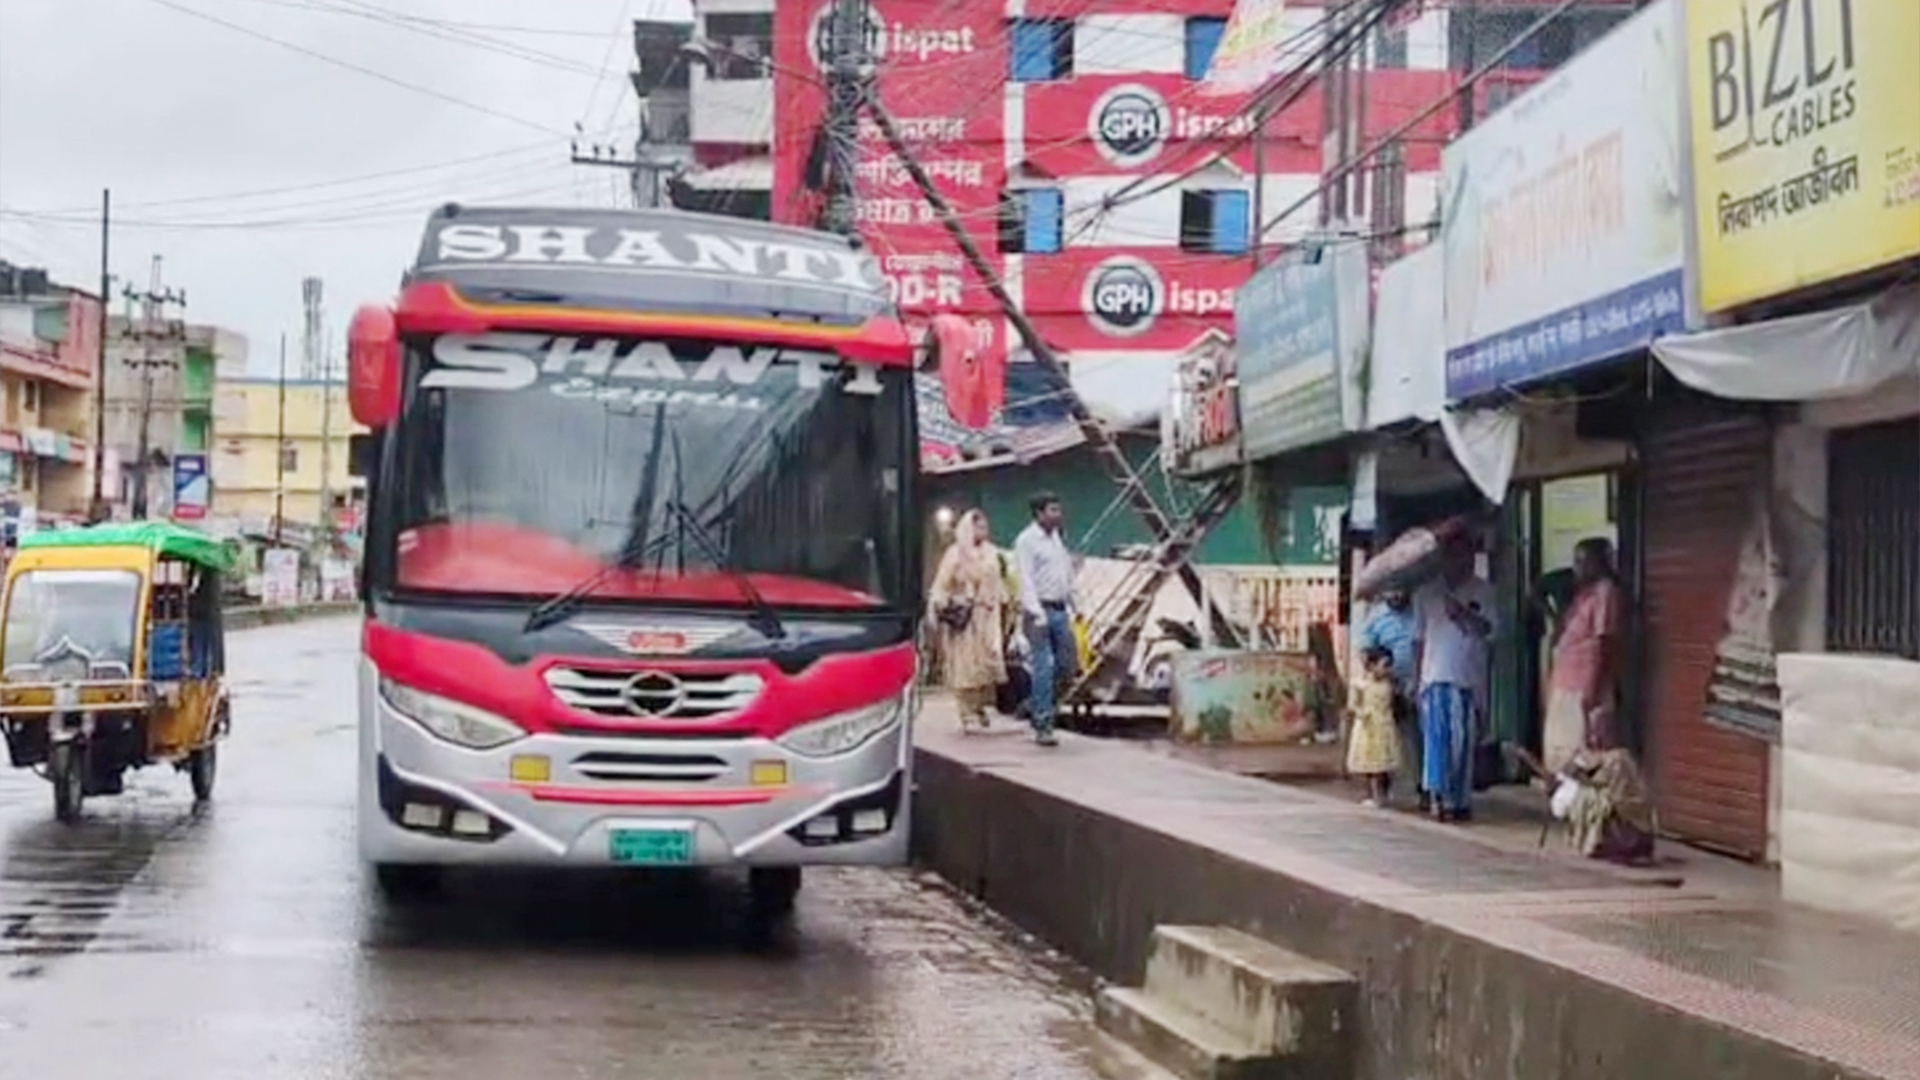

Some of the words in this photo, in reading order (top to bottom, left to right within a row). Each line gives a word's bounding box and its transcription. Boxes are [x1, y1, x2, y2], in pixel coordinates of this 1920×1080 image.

[892, 22, 975, 62] ispat
[1708, 0, 1854, 134] BIZLI
[1102, 111, 1157, 141] GPH
[1771, 79, 1856, 147] CABLES
[1781, 146, 1859, 215] আজীবন
[437, 224, 884, 291] SHANTI
[1096, 283, 1150, 314] GPH
[1169, 280, 1236, 315] ispa
[419, 331, 886, 395] SHANTI
